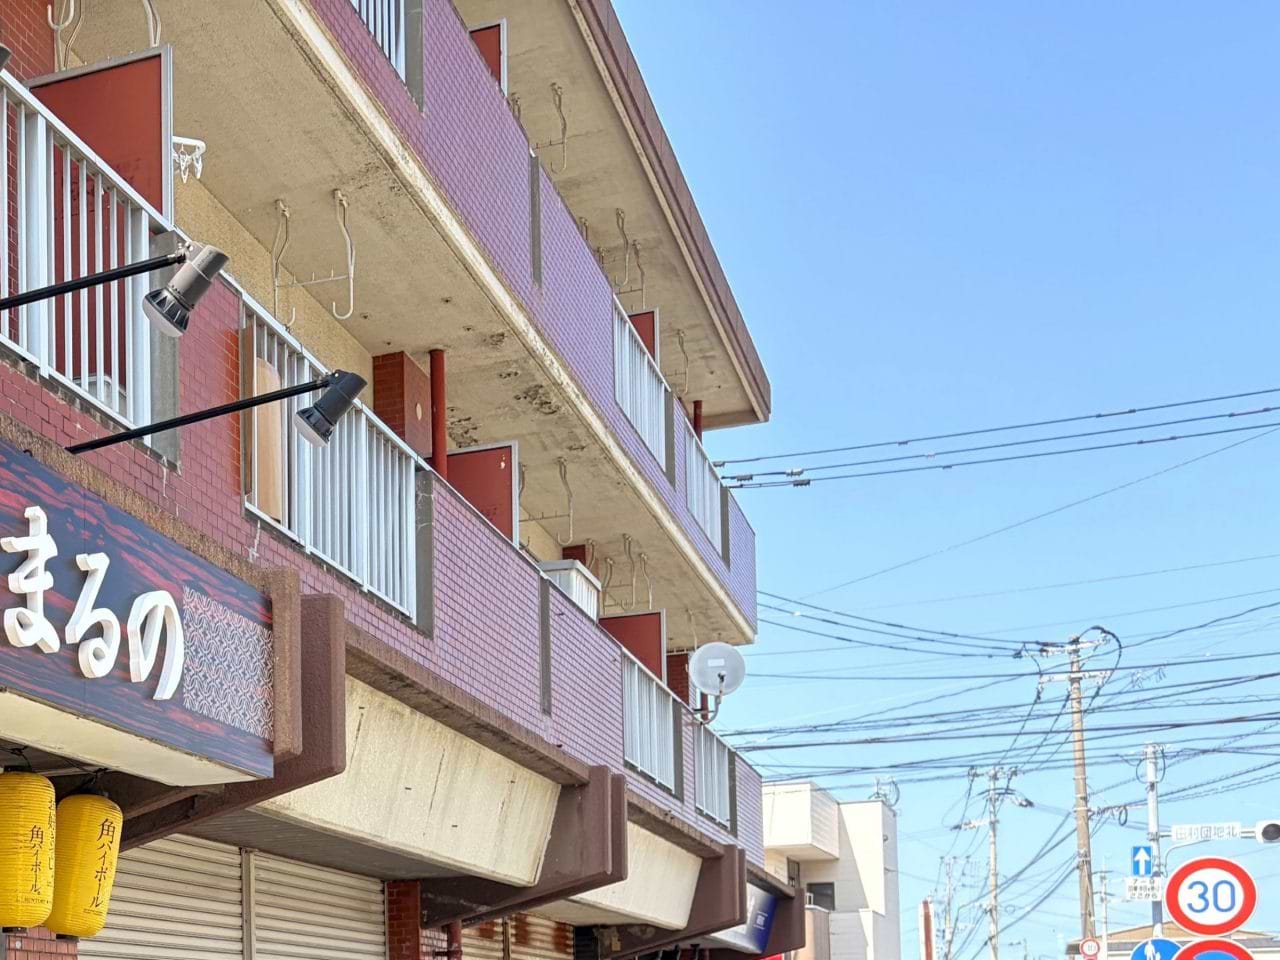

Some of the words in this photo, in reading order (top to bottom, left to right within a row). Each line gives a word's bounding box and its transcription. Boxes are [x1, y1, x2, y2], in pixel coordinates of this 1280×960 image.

[0, 505, 185, 701] まるの
[90, 818, 116, 908] 角ハイボール
[1187, 879, 1236, 914] 30
